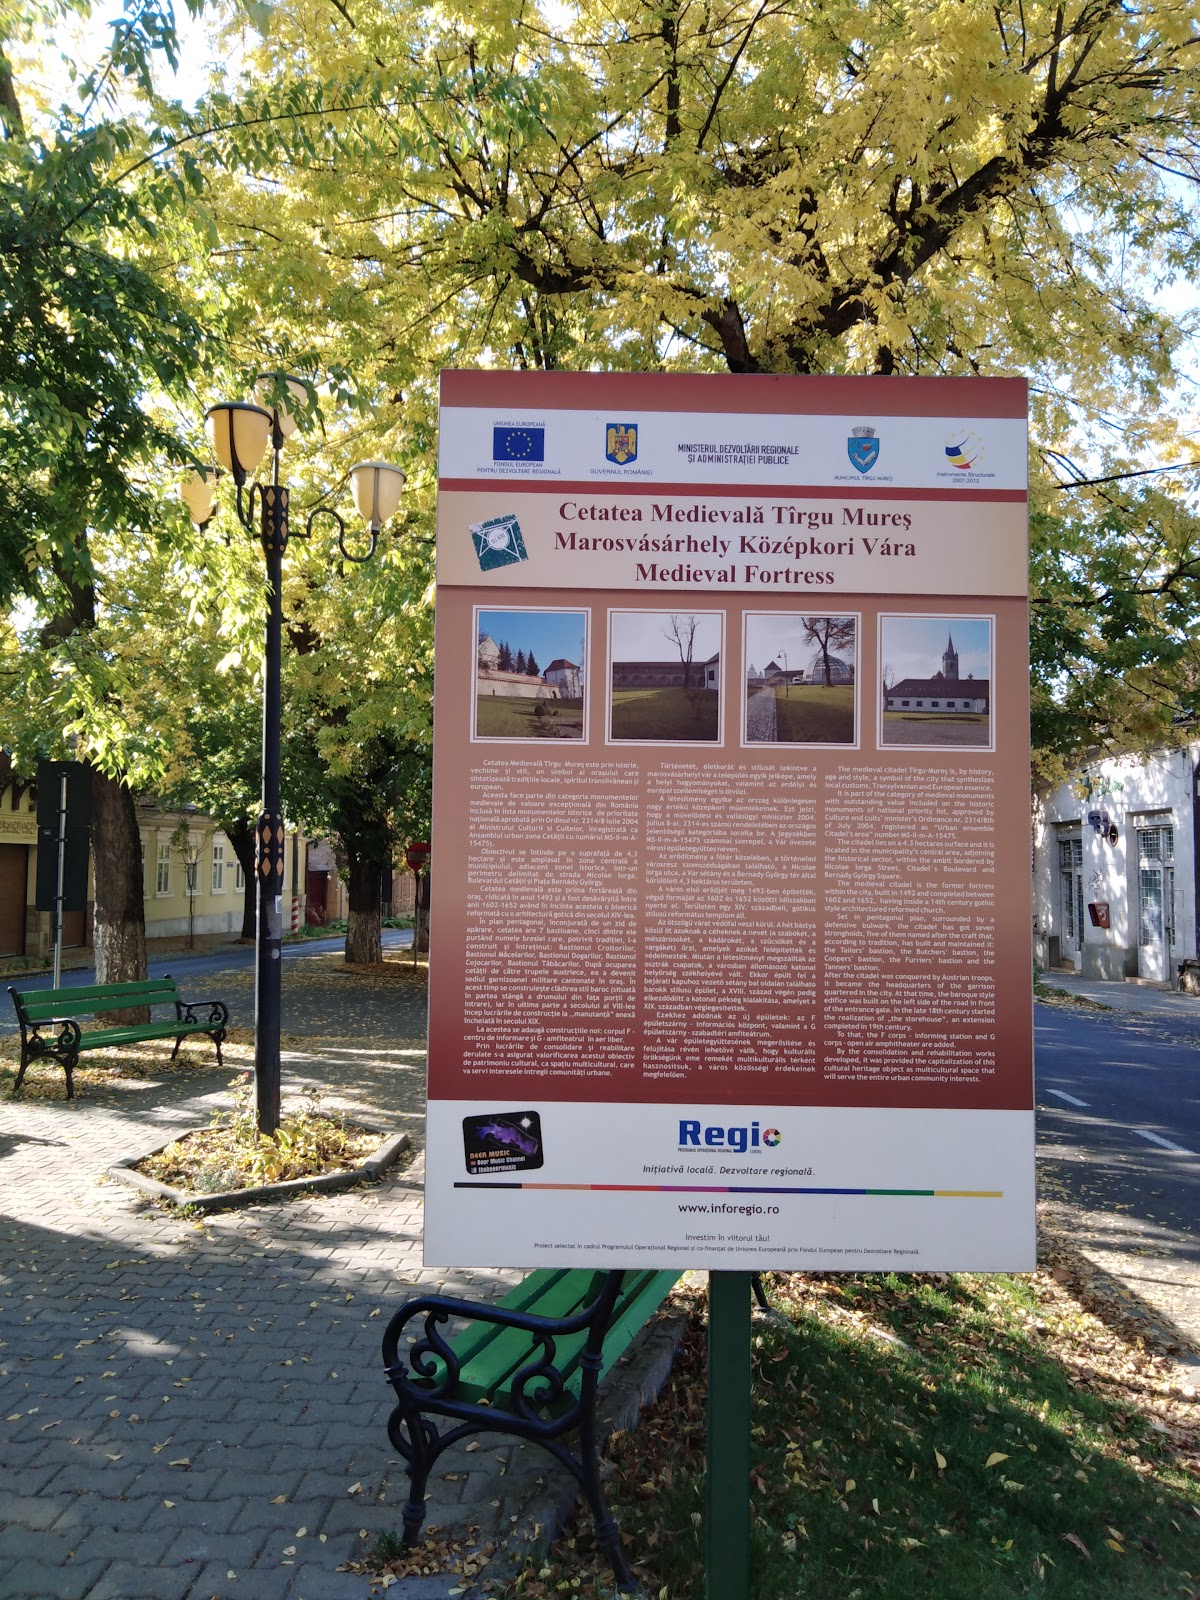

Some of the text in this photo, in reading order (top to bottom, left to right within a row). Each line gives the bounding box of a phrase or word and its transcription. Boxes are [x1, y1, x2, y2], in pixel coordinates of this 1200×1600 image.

[678, 443, 799, 455] MINISTERUL DEZVOLTĂRII REGIONALE
[758, 456, 789, 464] PUBLICE
[559, 502, 643, 521] Cetatea
[651, 504, 764, 523] Medievală
[772, 506, 834, 530] Tîrgu
[554, 532, 916, 559] Marosvásárhely Középkori Vára
[635, 563, 835, 584] Medieval Fortress
[959, 768, 967, 776] by
[844, 798, 883, 807] outstanding
[959, 923, 970, 932] got
[886, 981, 931, 990] headquarters
[968, 982, 995, 992] garrison
[837, 1048, 845, 1056] By
[852, 1065, 880, 1074] heritage
[882, 1065, 904, 1074] object
[687, 1166, 716, 1174] locală.
[720, 1166, 768, 1175] Dezvoltare
[770, 1167, 815, 1177] regională.
[678, 1203, 780, 1216] www.inforegio.ro
